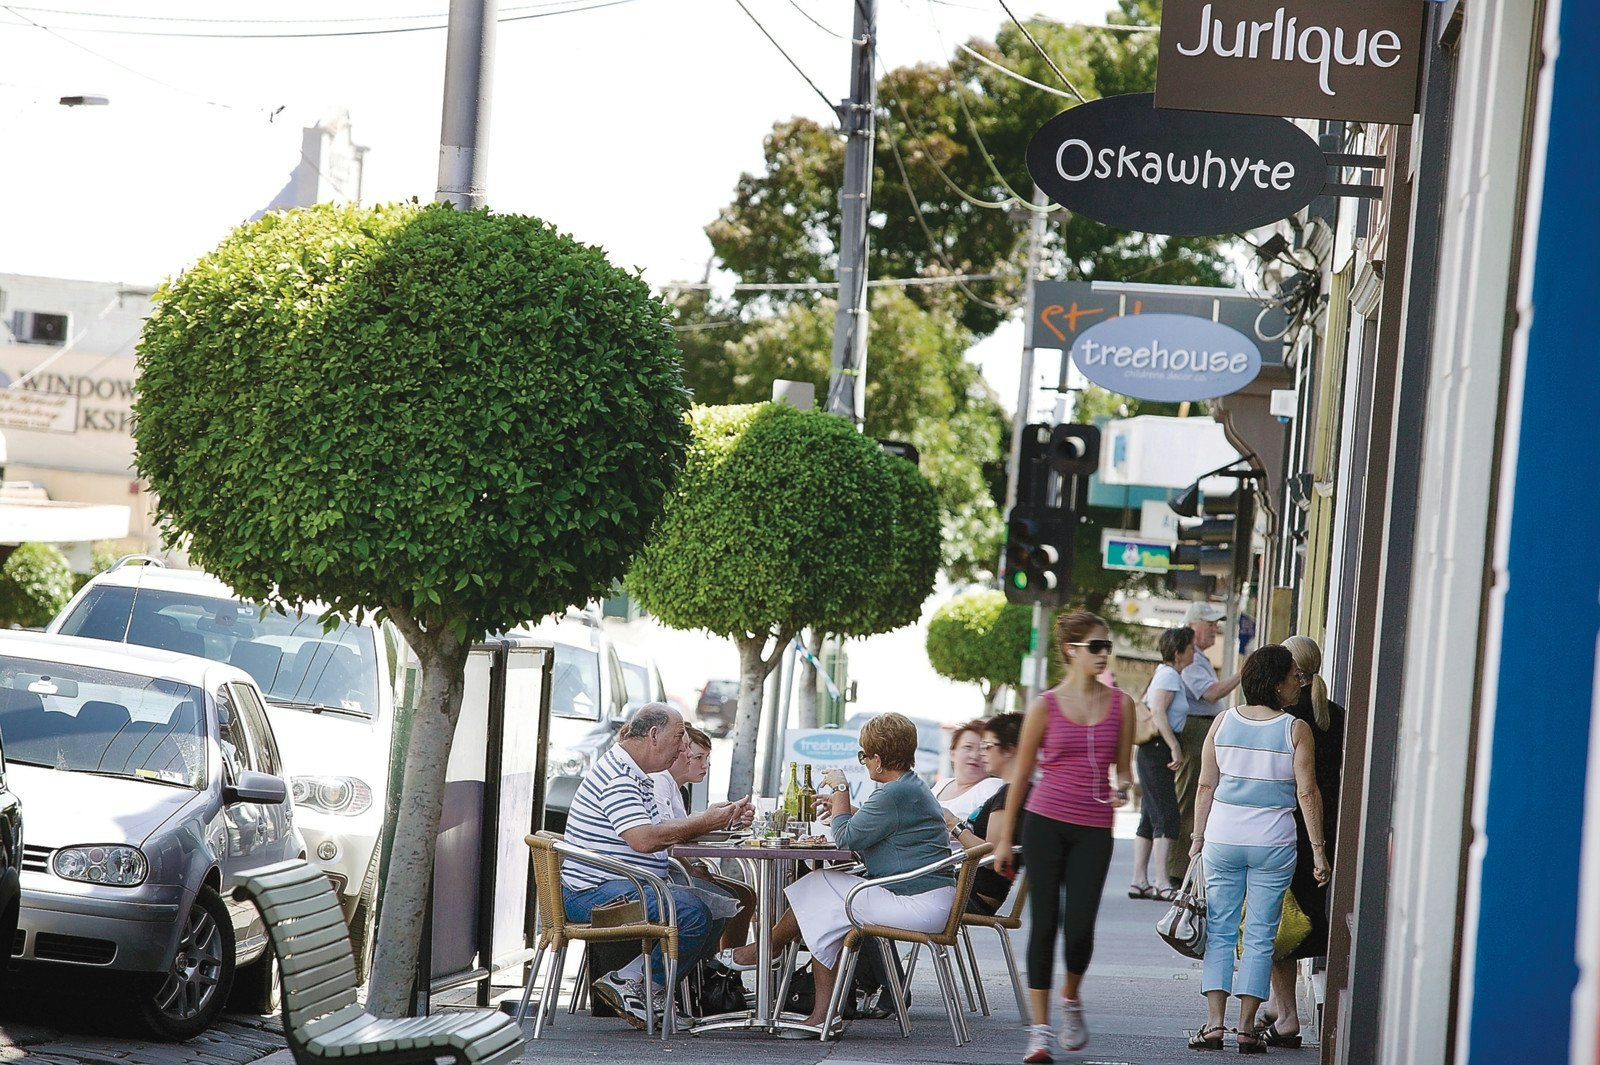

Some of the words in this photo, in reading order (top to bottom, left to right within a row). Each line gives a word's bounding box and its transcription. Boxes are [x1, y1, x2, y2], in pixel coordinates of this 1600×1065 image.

[1176, 3, 1402, 97] Jurlique
[1055, 138, 1296, 192] Oskawhyte
[1080, 339, 1250, 374] treehouse
